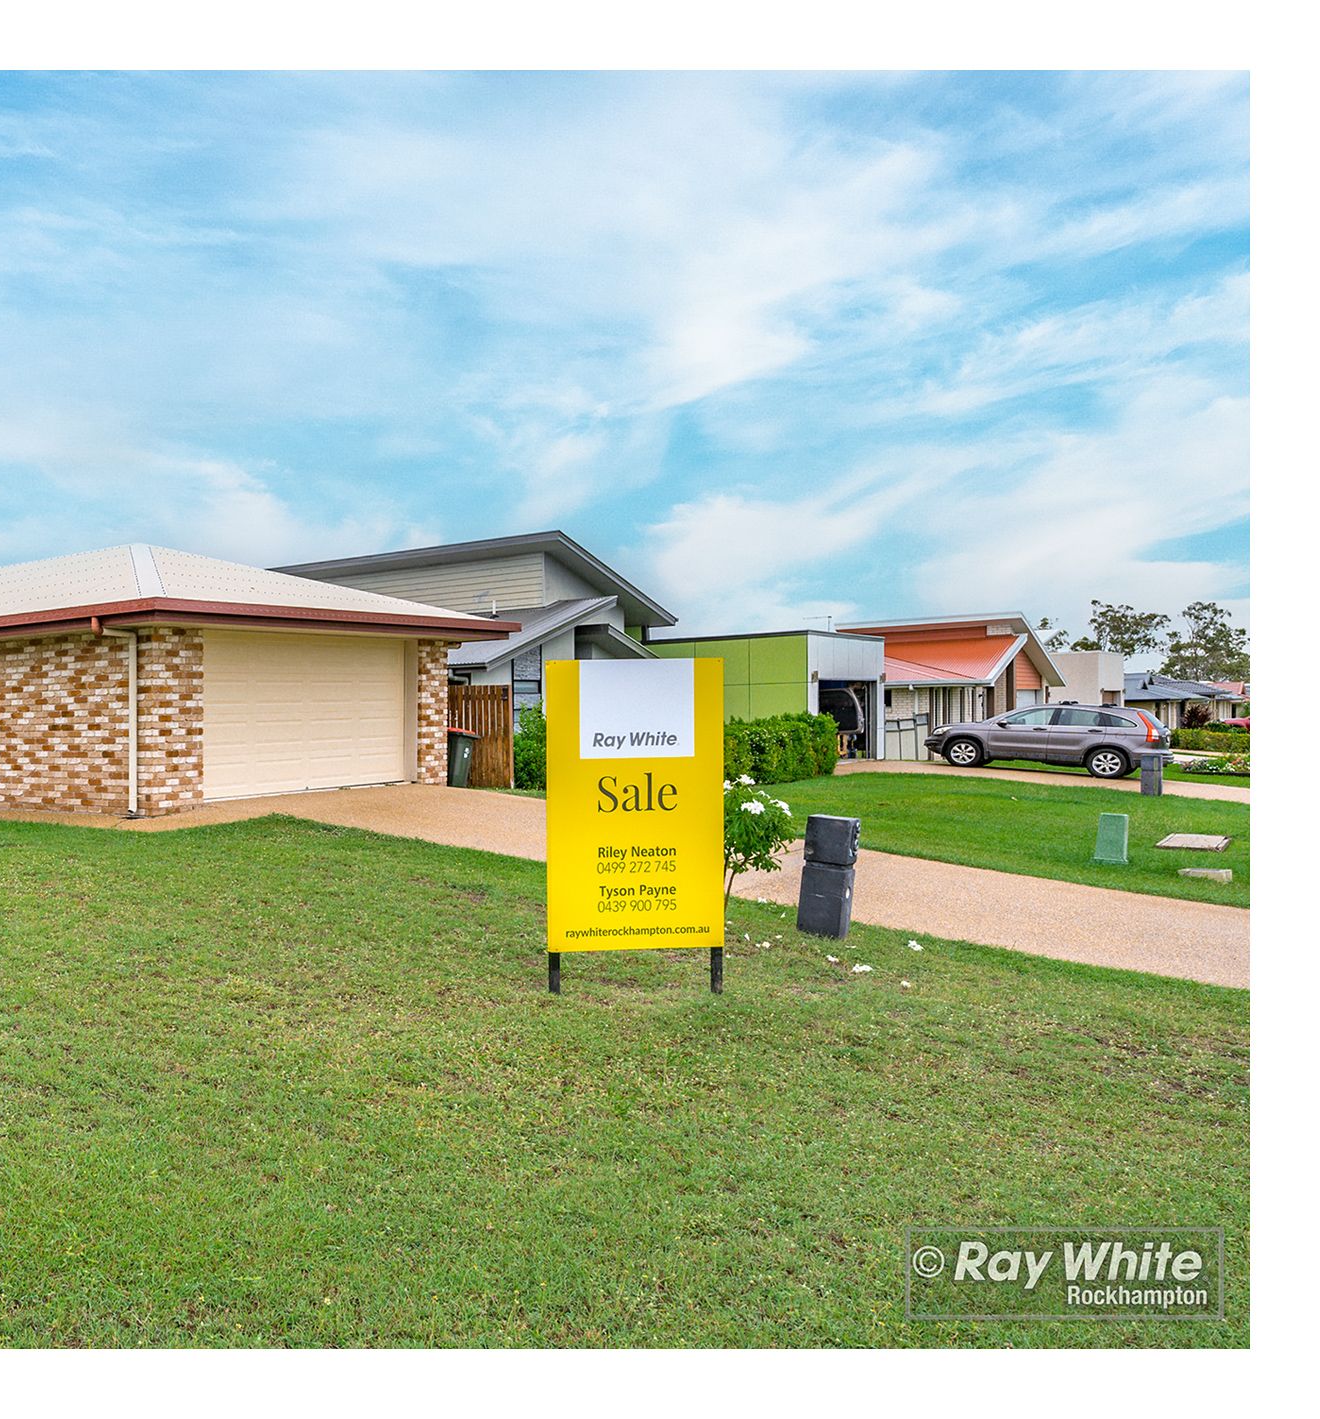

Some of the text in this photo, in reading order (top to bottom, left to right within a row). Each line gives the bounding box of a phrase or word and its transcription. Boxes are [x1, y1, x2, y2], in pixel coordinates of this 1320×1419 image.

[592, 731, 678, 748] Ray White
[597, 772, 678, 813] Sale
[598, 846, 677, 860] Riley Neaton
[596, 860, 676, 874] 0499 272 745
[599, 884, 676, 899] Tyson Payne
[597, 899, 677, 913] 0439 900 795
[565, 924, 710, 938] raywhiterockhampton.com.au
